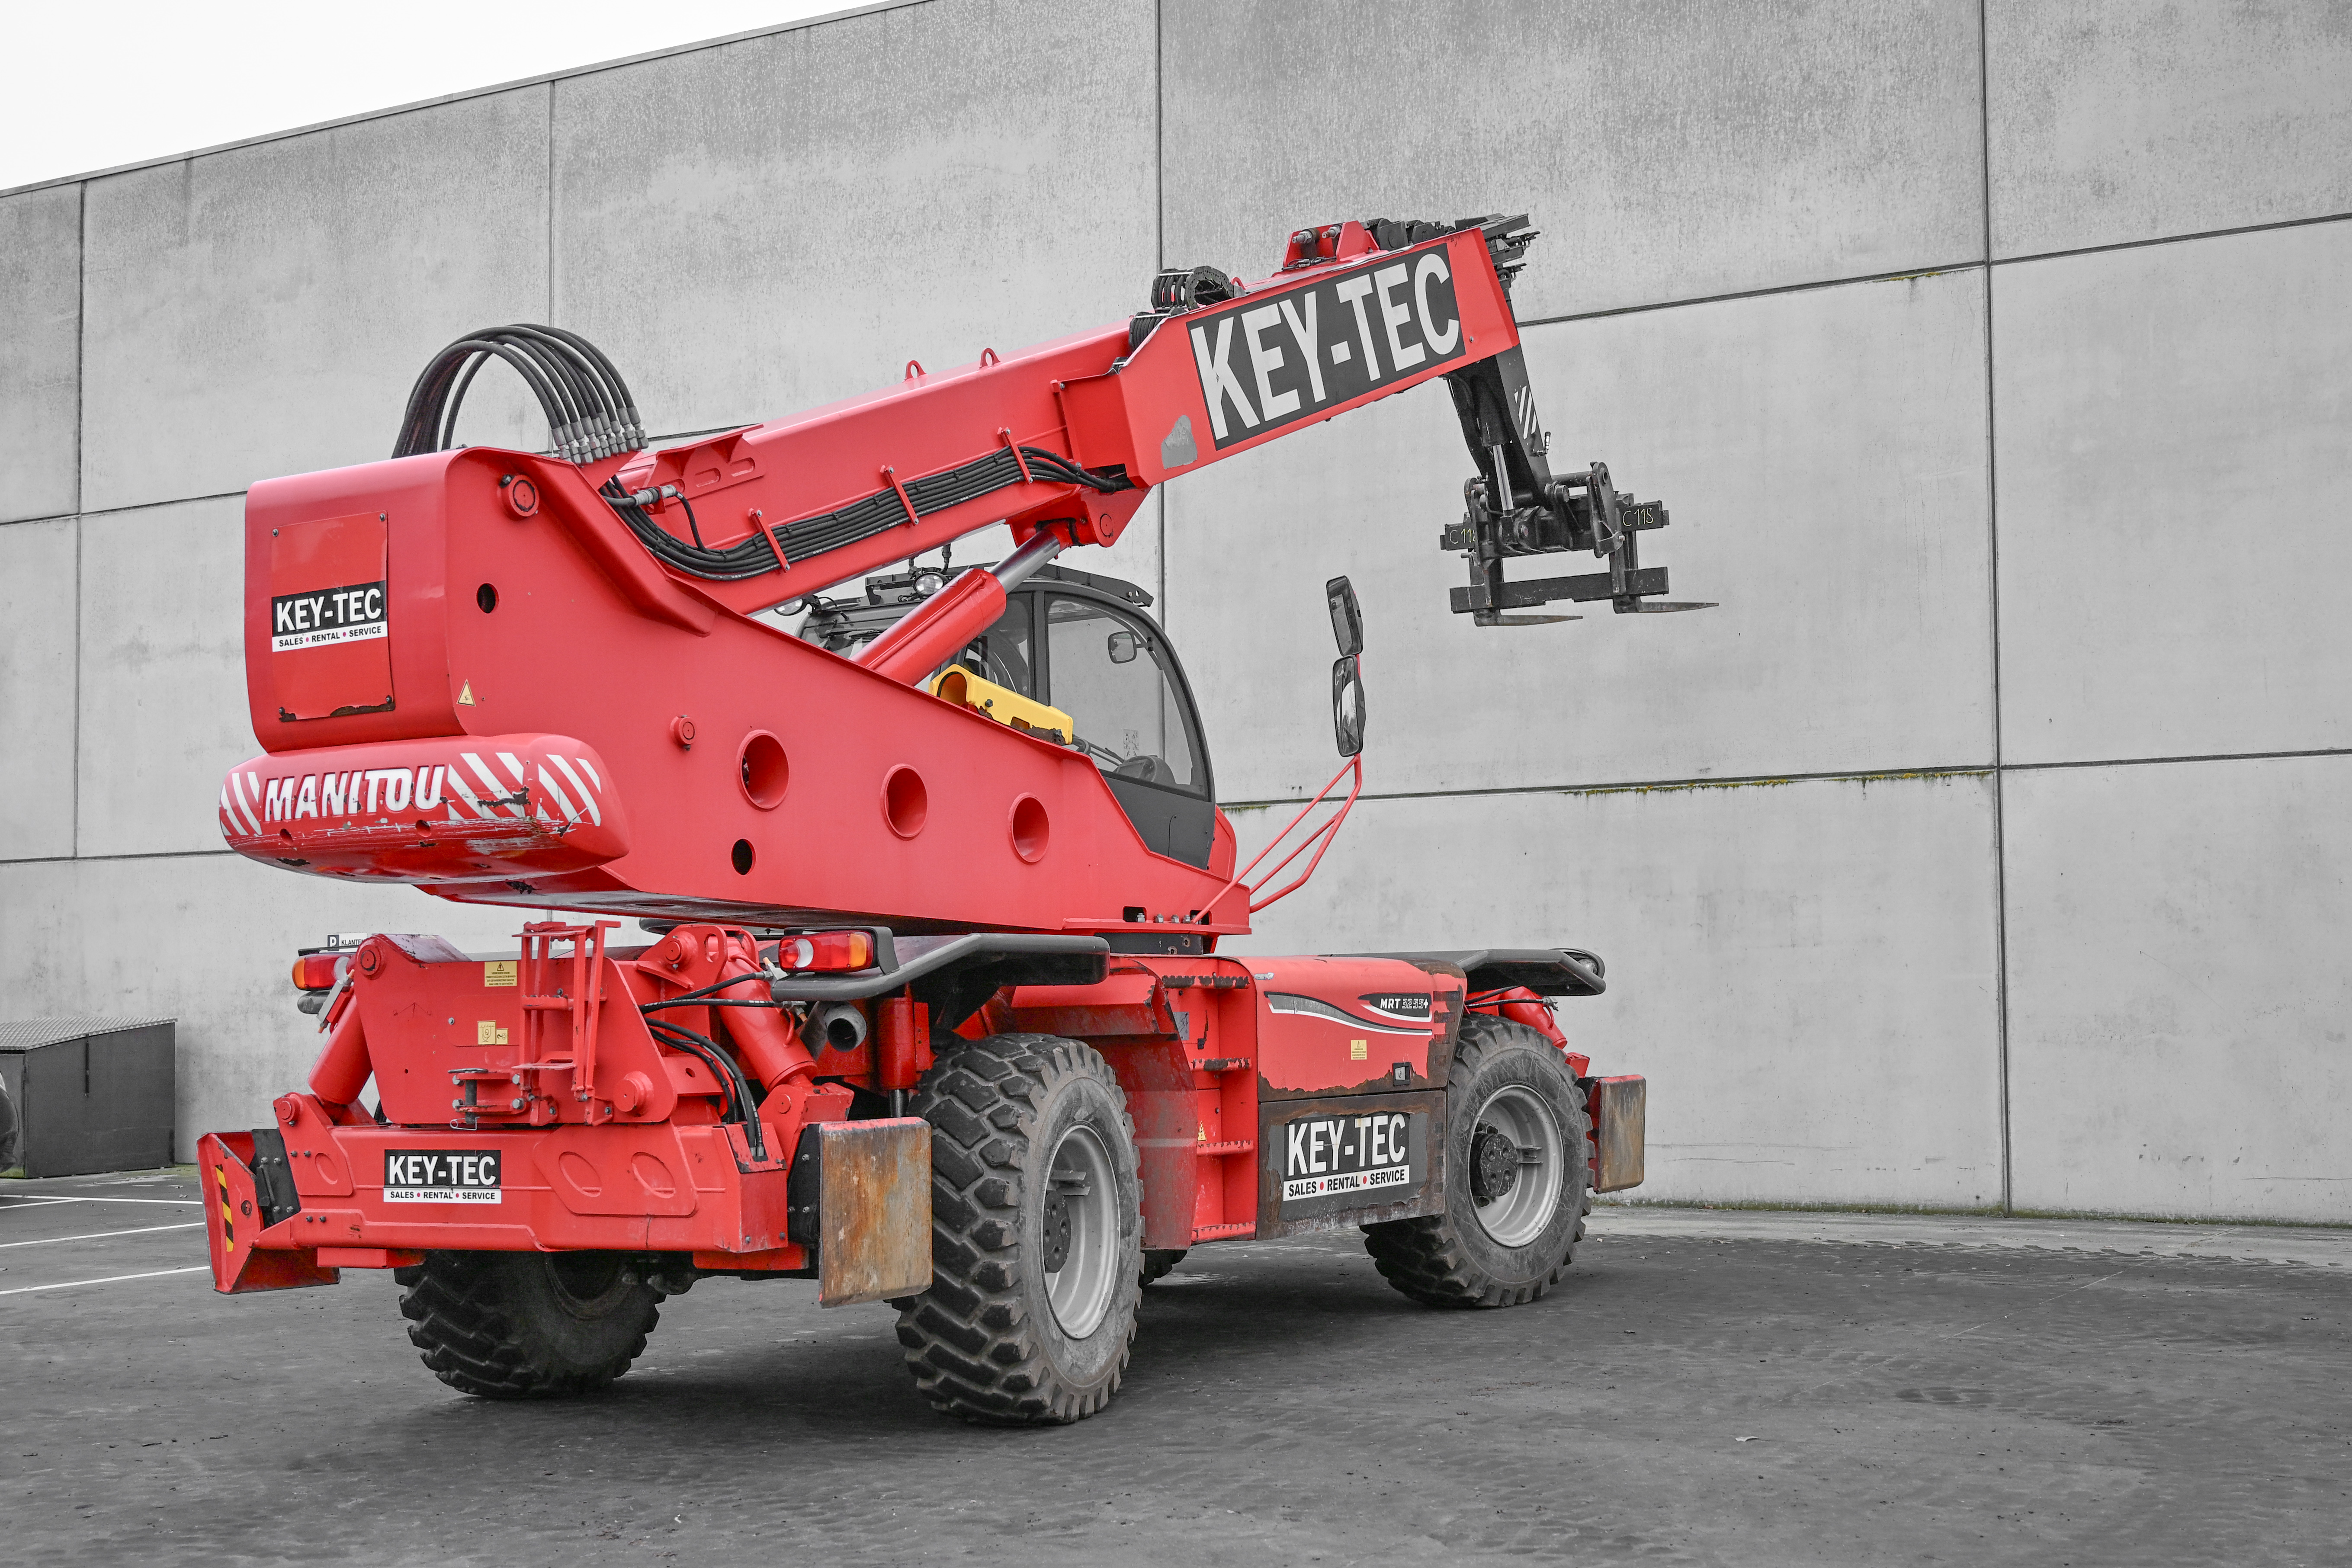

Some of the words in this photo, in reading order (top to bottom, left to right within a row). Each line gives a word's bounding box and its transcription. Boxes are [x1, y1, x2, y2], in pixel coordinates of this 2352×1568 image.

[1190, 253, 1459, 440] KEY-TEC
[277, 588, 382, 632] KEY-TEC
[279, 637, 303, 647] SALES
[311, 632, 340, 642] RENTAL
[349, 626, 382, 637] SERVICE
[264, 764, 445, 822] MANITOU
[1380, 998, 1401, 1009] MRT
[1402, 998, 1428, 1009] 3255+
[1288, 1113, 1405, 1176] KEY-TEC
[389, 1155, 496, 1185] KEY-TEC
[1289, 1181, 1317, 1197] SALES
[1327, 1175, 1360, 1191] RENTAL
[1370, 1169, 1405, 1185] SERVICE
